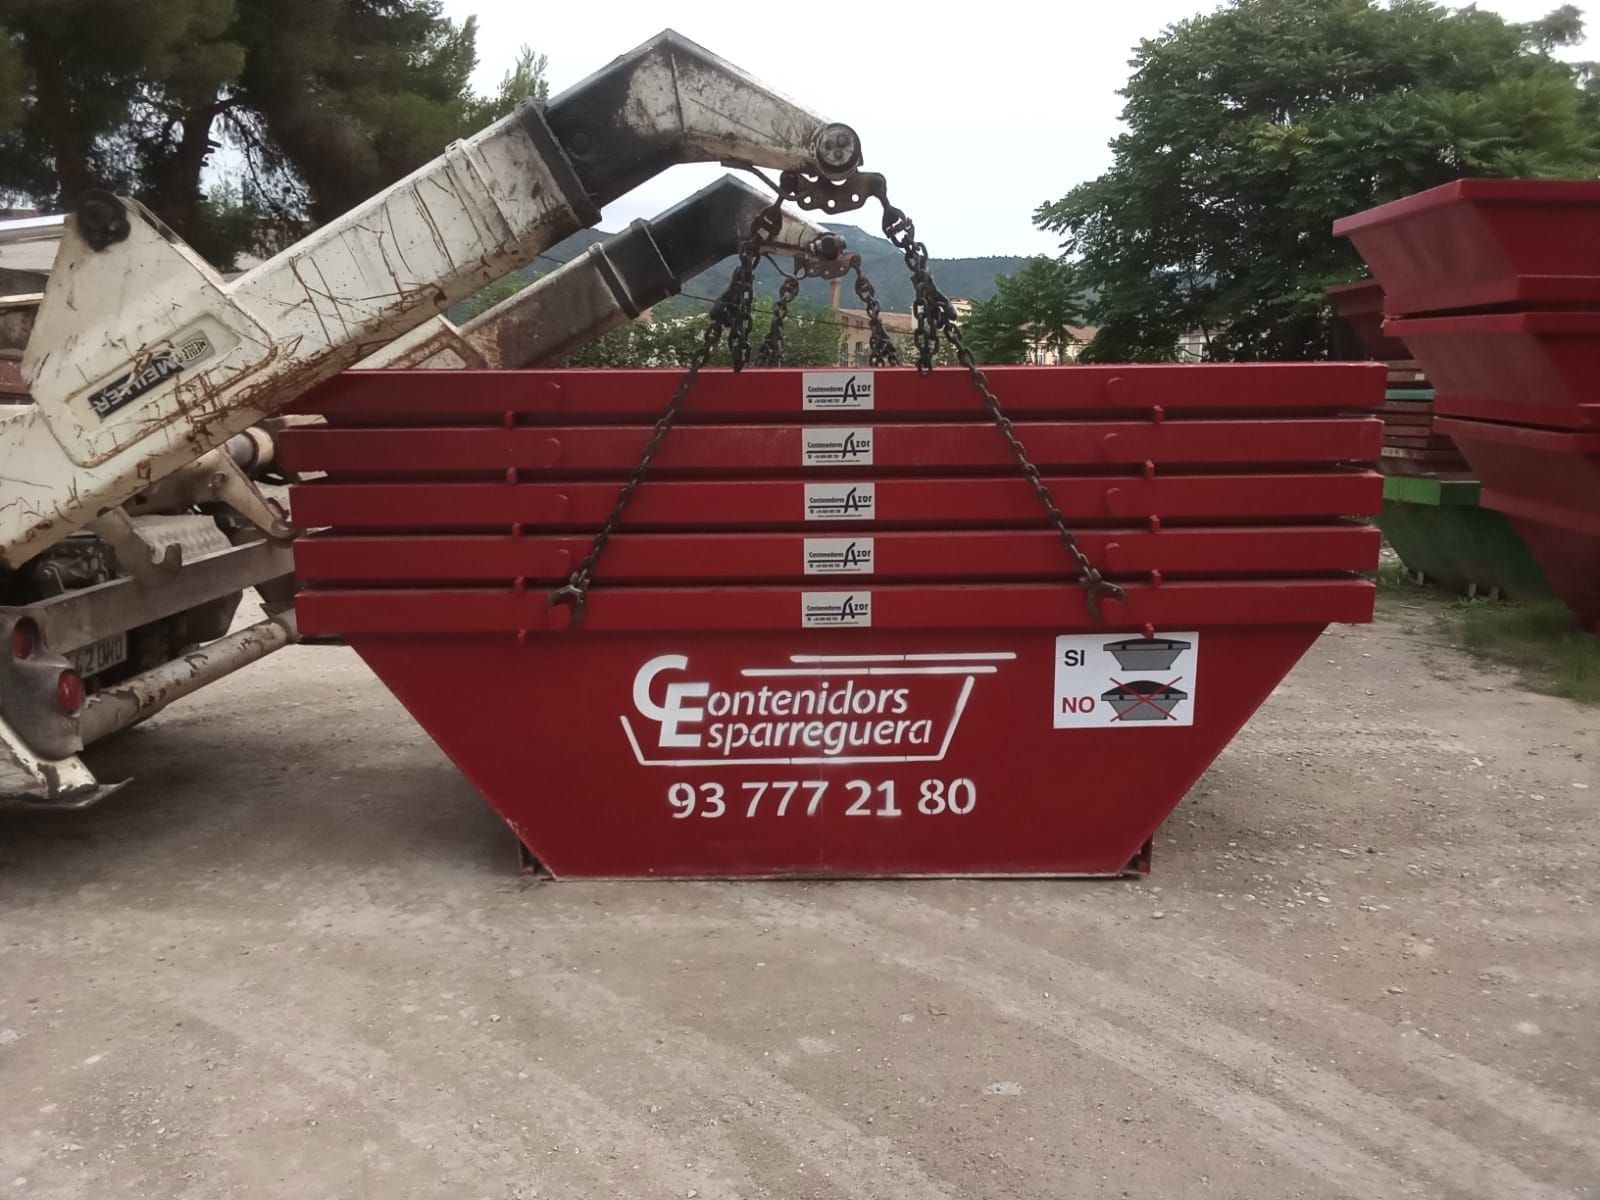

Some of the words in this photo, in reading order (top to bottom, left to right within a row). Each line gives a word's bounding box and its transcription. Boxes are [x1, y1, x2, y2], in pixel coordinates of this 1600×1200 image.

[1064, 649, 1085, 667] SI
[1061, 696, 1095, 713] NO
[667, 782, 726, 819] 93
[741, 780, 829, 818] 777
[844, 779, 902, 817] 21
[917, 778, 977, 815] 80
